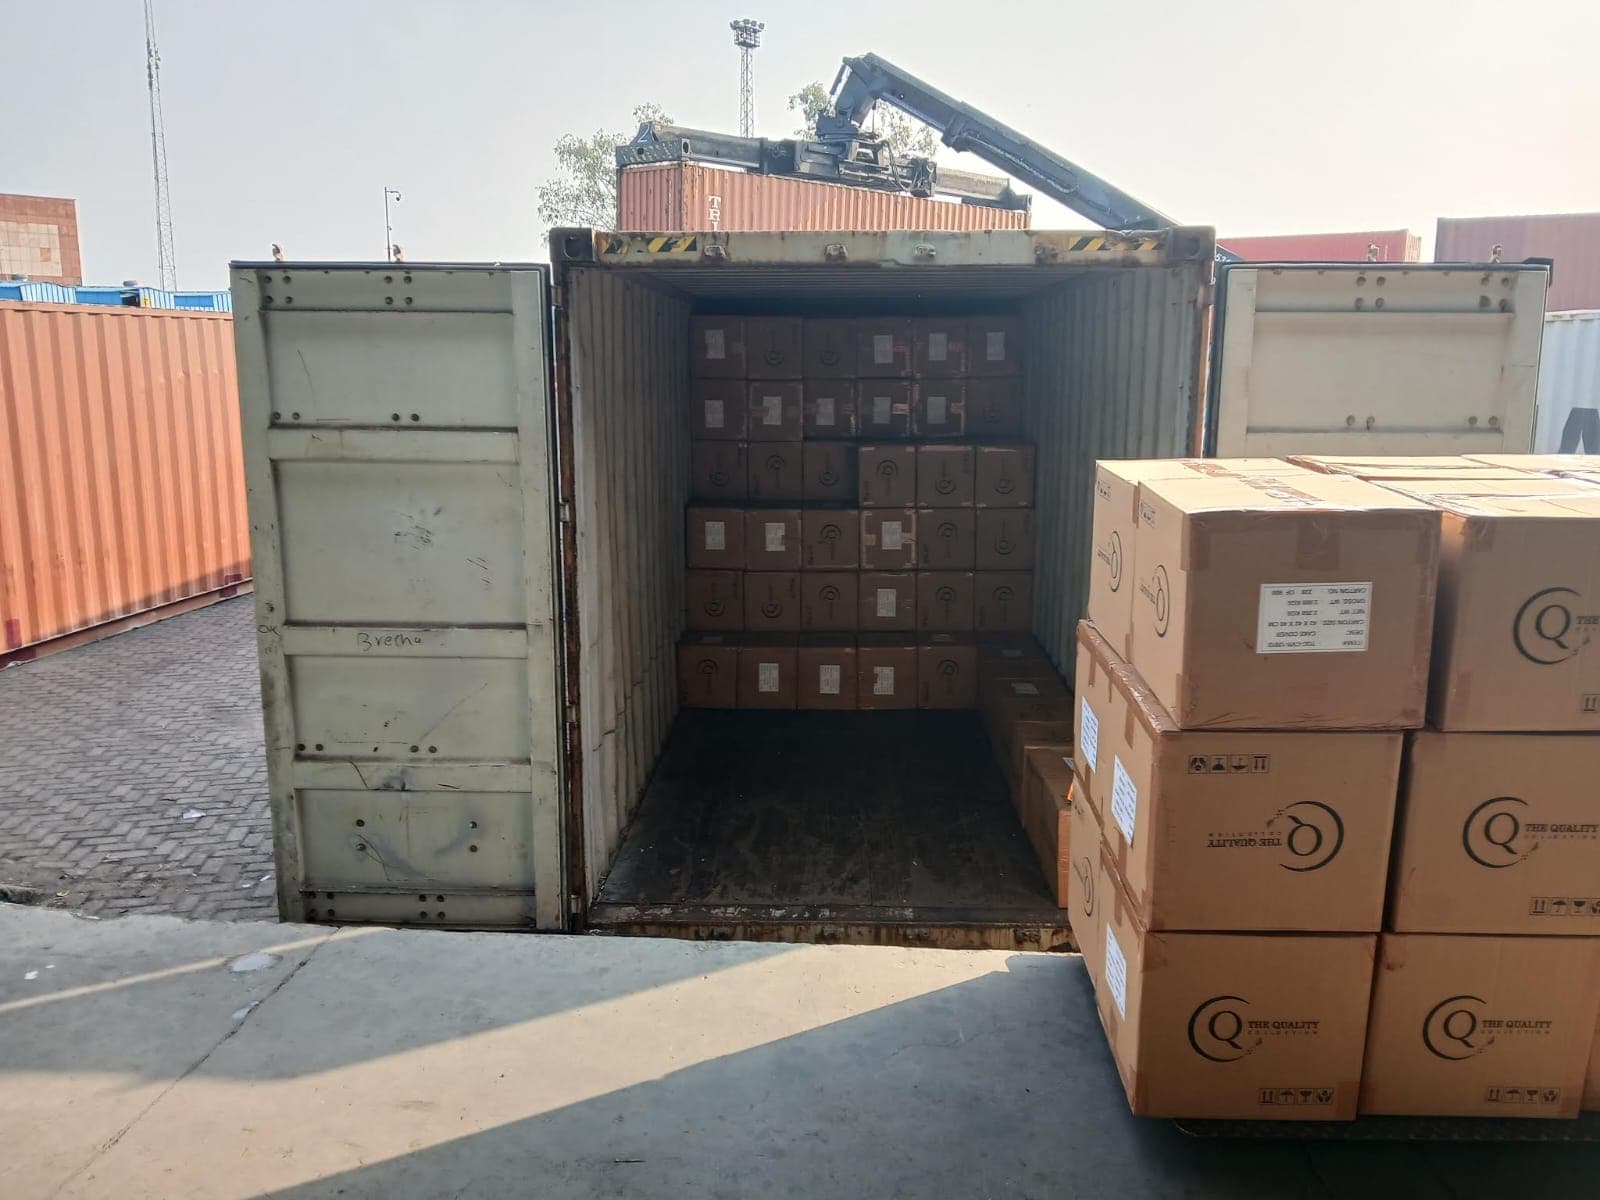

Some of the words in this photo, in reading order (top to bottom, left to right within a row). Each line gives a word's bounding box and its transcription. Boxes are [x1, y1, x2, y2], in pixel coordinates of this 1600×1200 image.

[1525, 823, 1549, 832] THE
[1550, 823, 1600, 833] QUALITY
[1207, 837, 1257, 848] QUALITY
[1259, 838, 1282, 847] THE
[1247, 1021, 1270, 1030] THE
[1272, 1021, 1321, 1031] QUALITY
[1481, 1020, 1504, 1029] THE
[1506, 1020, 1553, 1030] QUALITY
